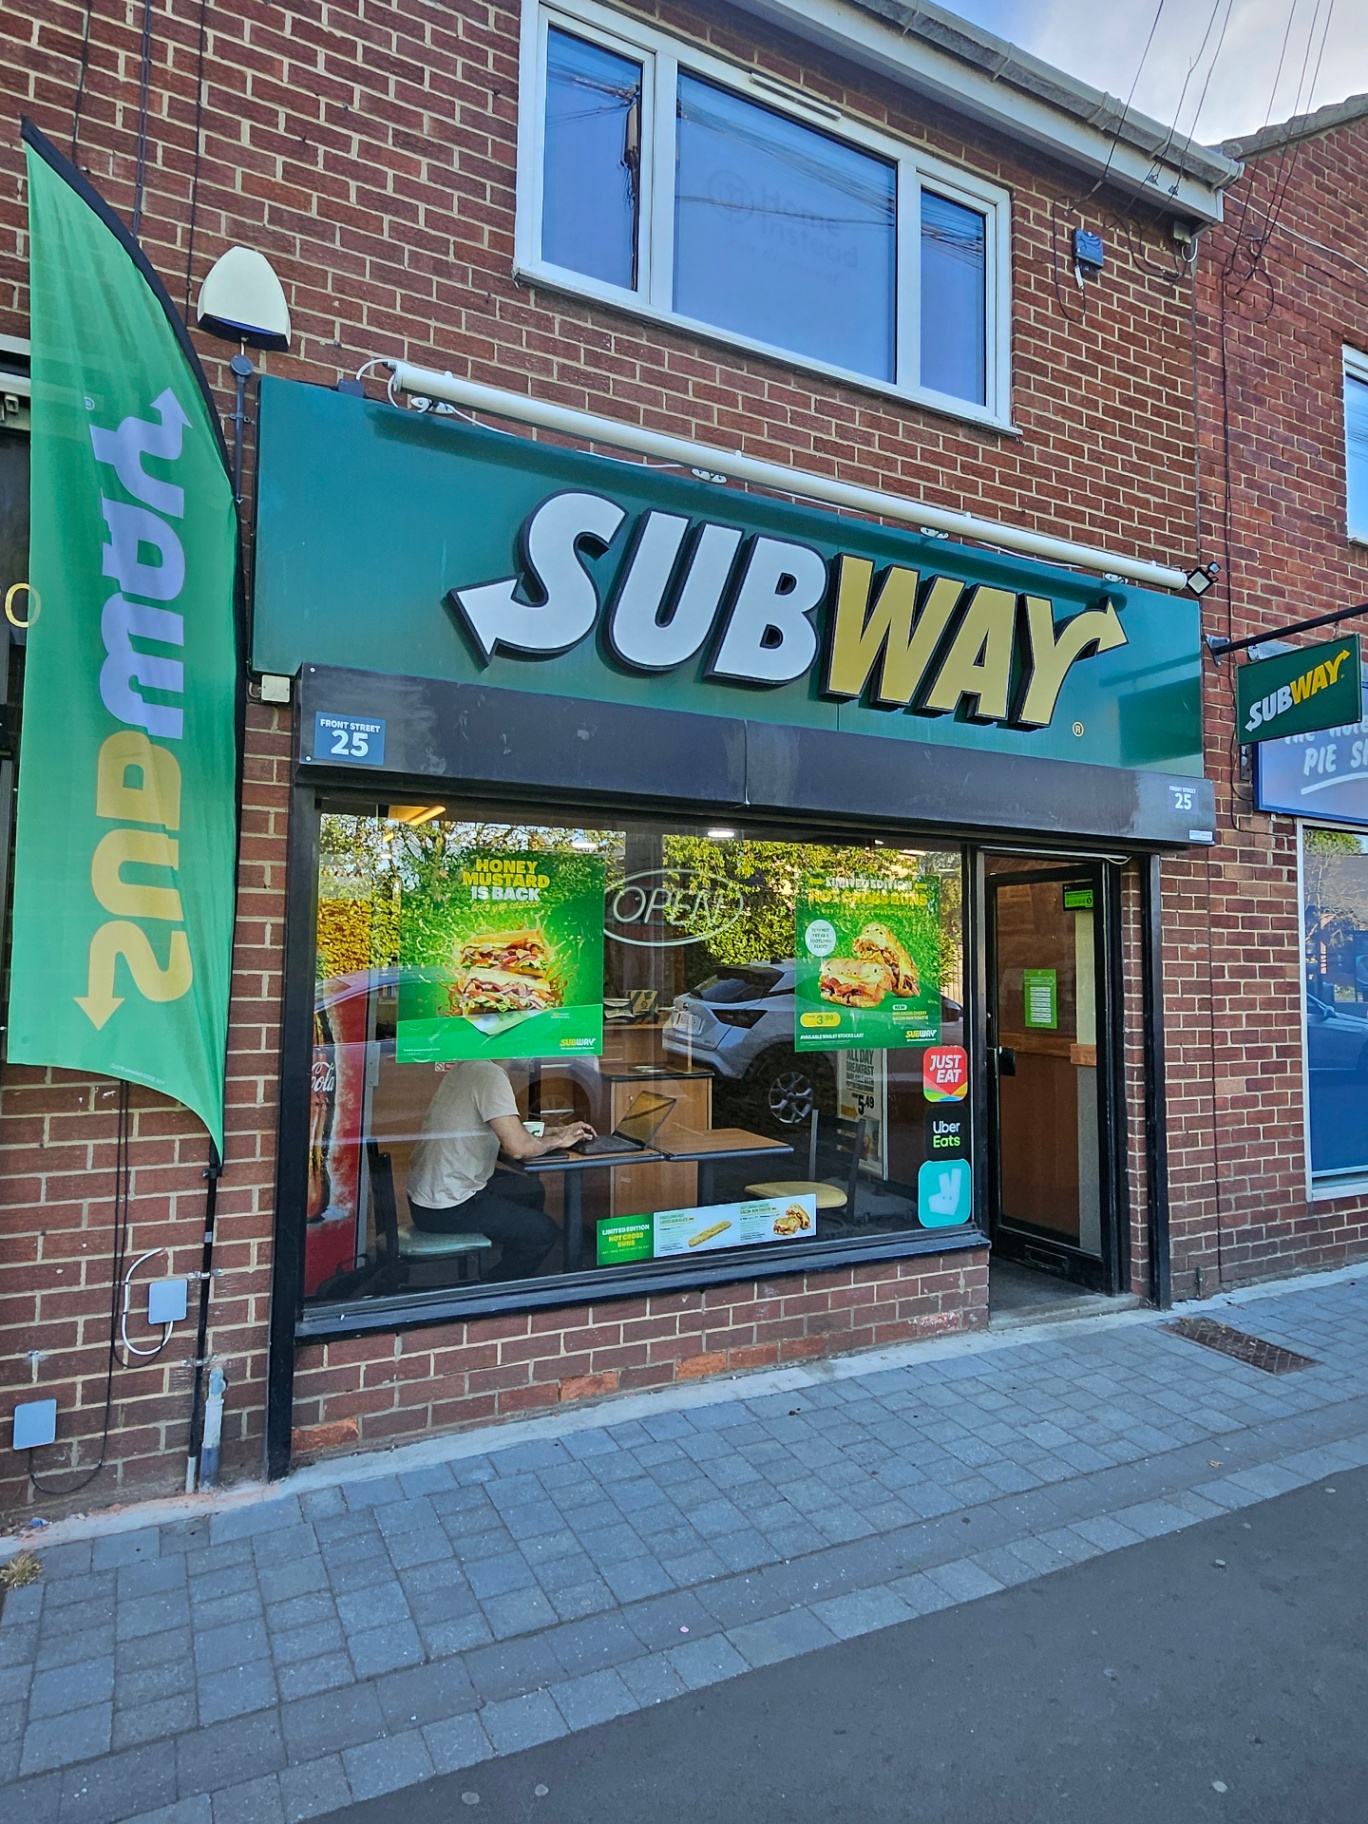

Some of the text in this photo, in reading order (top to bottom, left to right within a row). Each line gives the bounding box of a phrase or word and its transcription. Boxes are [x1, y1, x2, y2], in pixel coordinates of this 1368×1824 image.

[450, 488, 1129, 732] SUBWAY
[1245, 650, 1350, 732] SUBWAY
[320, 718, 381, 733] FRONT STREET
[331, 730, 369, 757] 25
[1303, 743, 1337, 776] PIE
[1174, 792, 1192, 810] 25
[476, 858, 538, 874] HONEY
[463, 872, 550, 888] MUSTARD
[471, 886, 541, 902] IS BACK
[890, 892, 928, 906] BUNS
[613, 886, 724, 926] OPEN
[905, 1029, 938, 1039] SUBWAY
[560, 1038, 597, 1047] SUBWAY
[847, 1049, 875, 1065] ALL DAY
[929, 1054, 962, 1072] JUST
[846, 1061, 875, 1077] BREAKFAST
[936, 1069, 962, 1083] EAT
[933, 1120, 961, 1134] Uber
[933, 1135, 961, 1148] Eats
[602, 1227, 626, 1236] LIMITED
[626, 1223, 650, 1232] EDITION
[608, 1231, 644, 1243] HOT CROSS
[617, 1240, 635, 1248] BUNS
